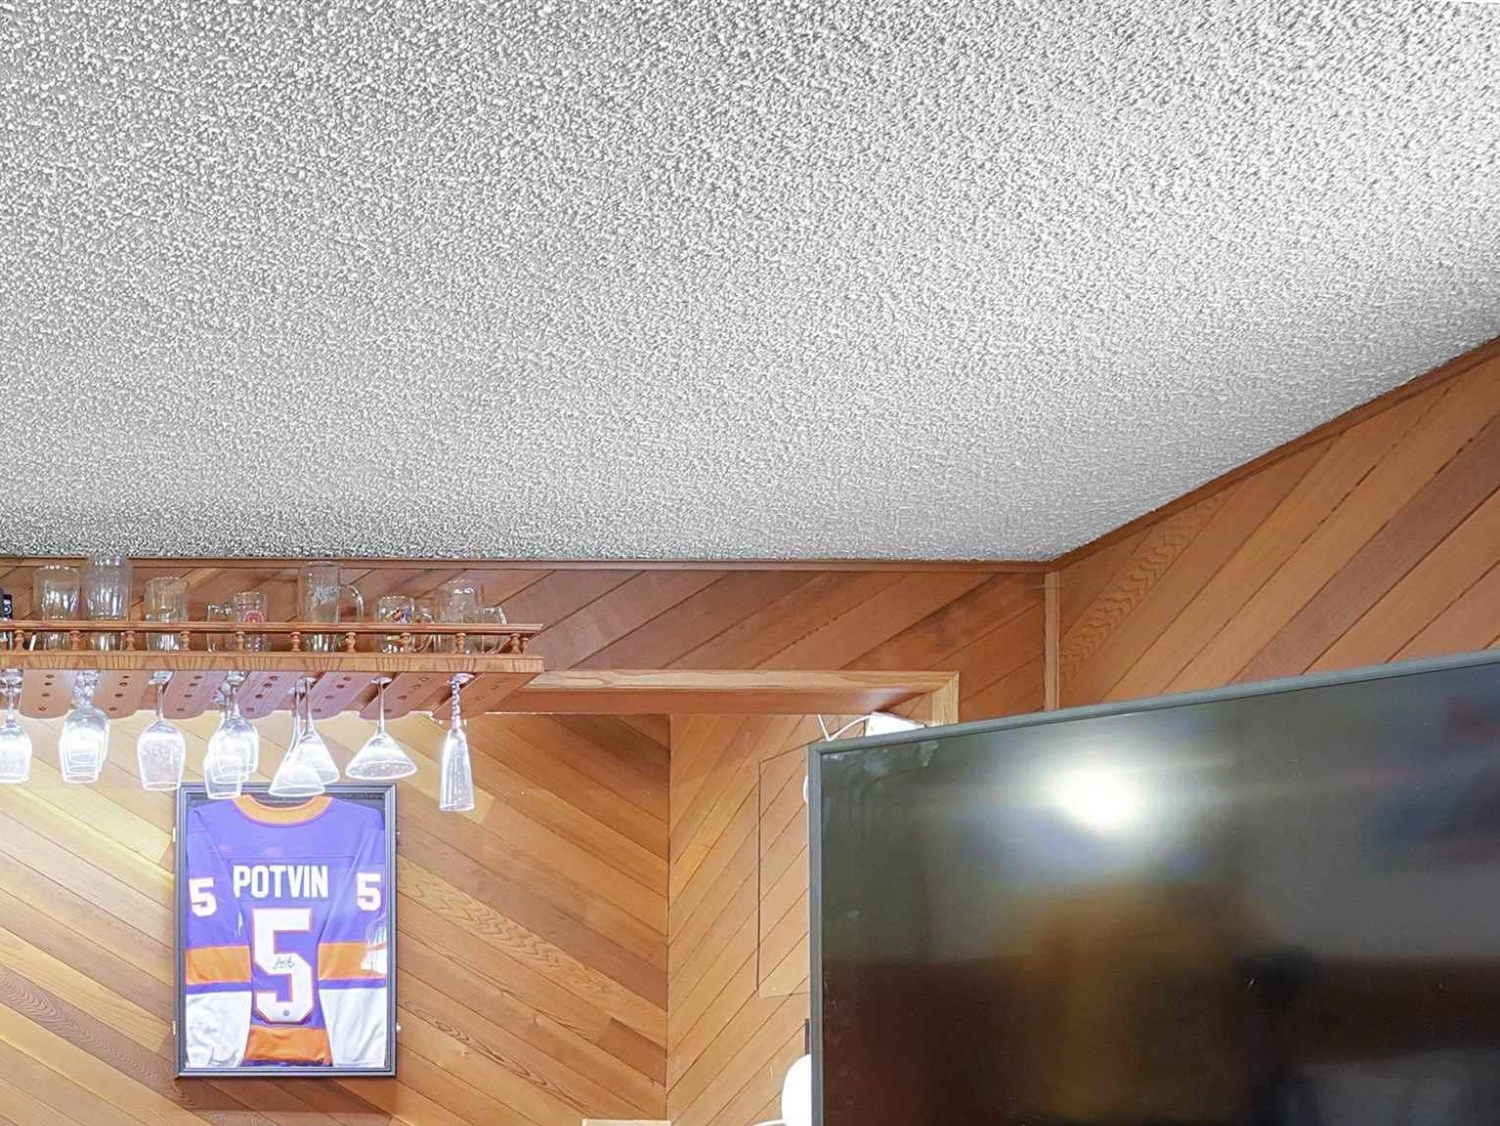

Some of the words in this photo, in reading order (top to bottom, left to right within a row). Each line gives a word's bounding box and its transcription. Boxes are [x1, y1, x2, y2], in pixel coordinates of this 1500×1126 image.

[188, 877, 217, 917] 5
[232, 864, 329, 899] POTVIN
[356, 872, 382, 912] 5
[252, 907, 314, 1023] 5
